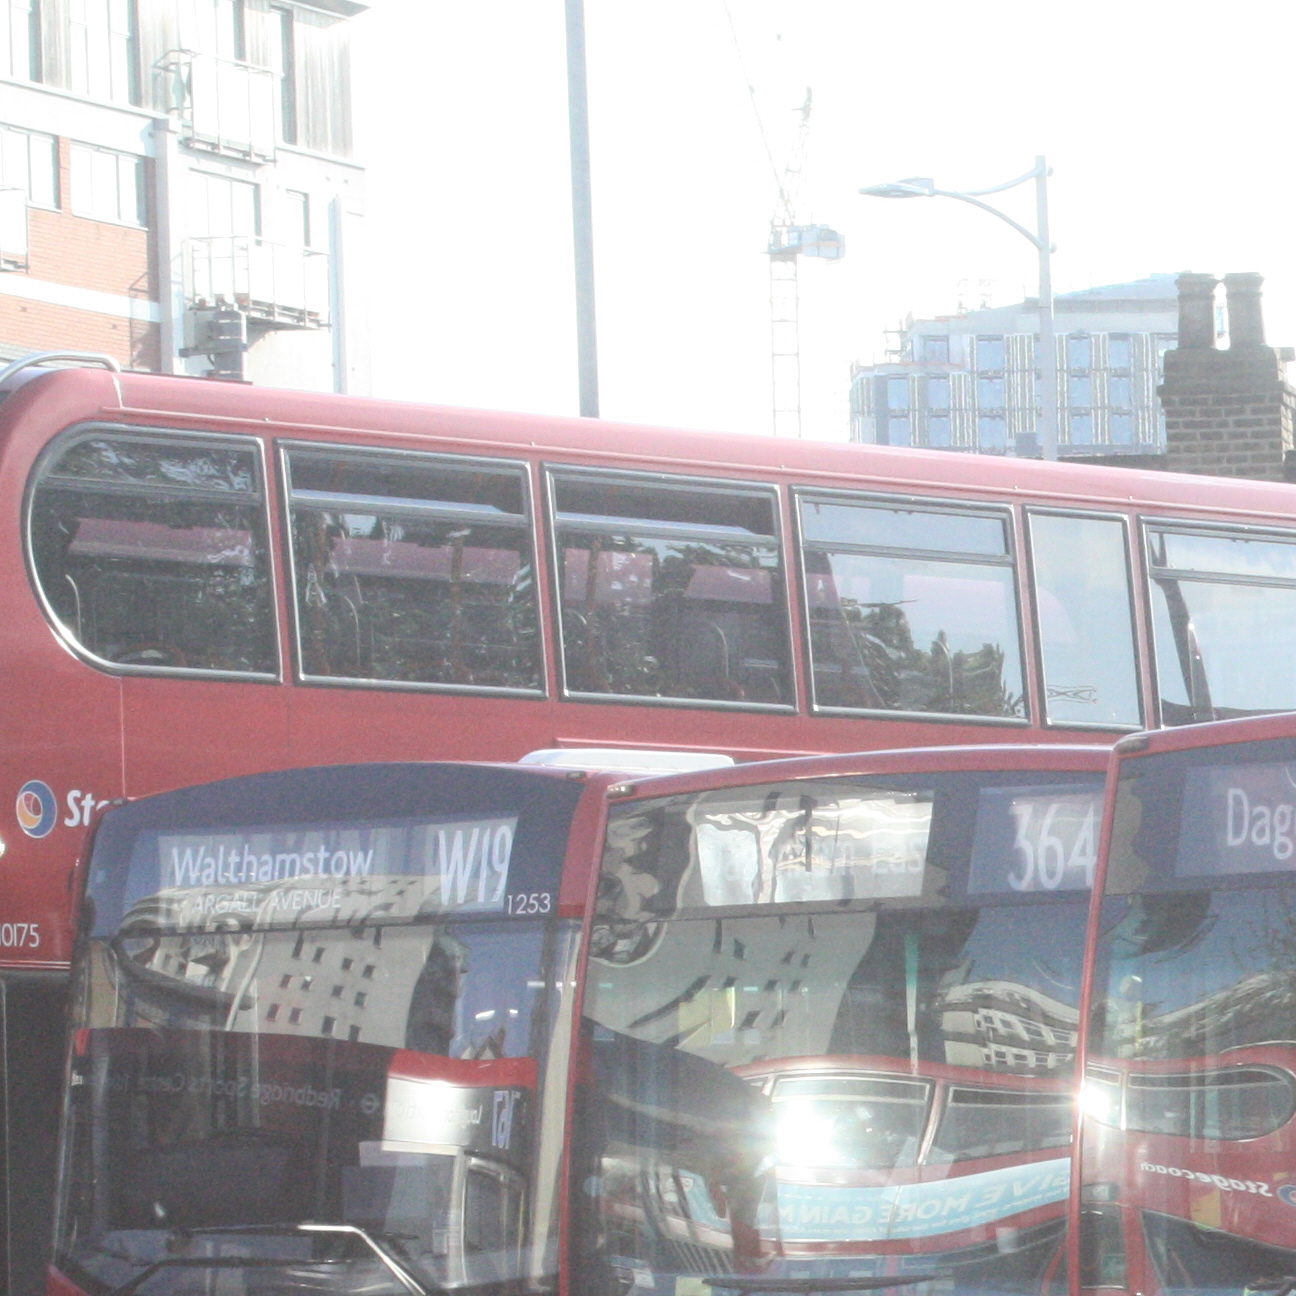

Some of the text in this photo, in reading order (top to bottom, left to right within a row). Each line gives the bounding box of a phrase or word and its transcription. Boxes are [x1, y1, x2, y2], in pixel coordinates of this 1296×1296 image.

[1006, 801, 1098, 892] 364
[172, 842, 374, 888] Walthamstow
[439, 825, 513, 906] W19
[271, 887, 342, 911] AVENUE
[506, 893, 551, 915] 1253
[0, 923, 40, 948] 0175
